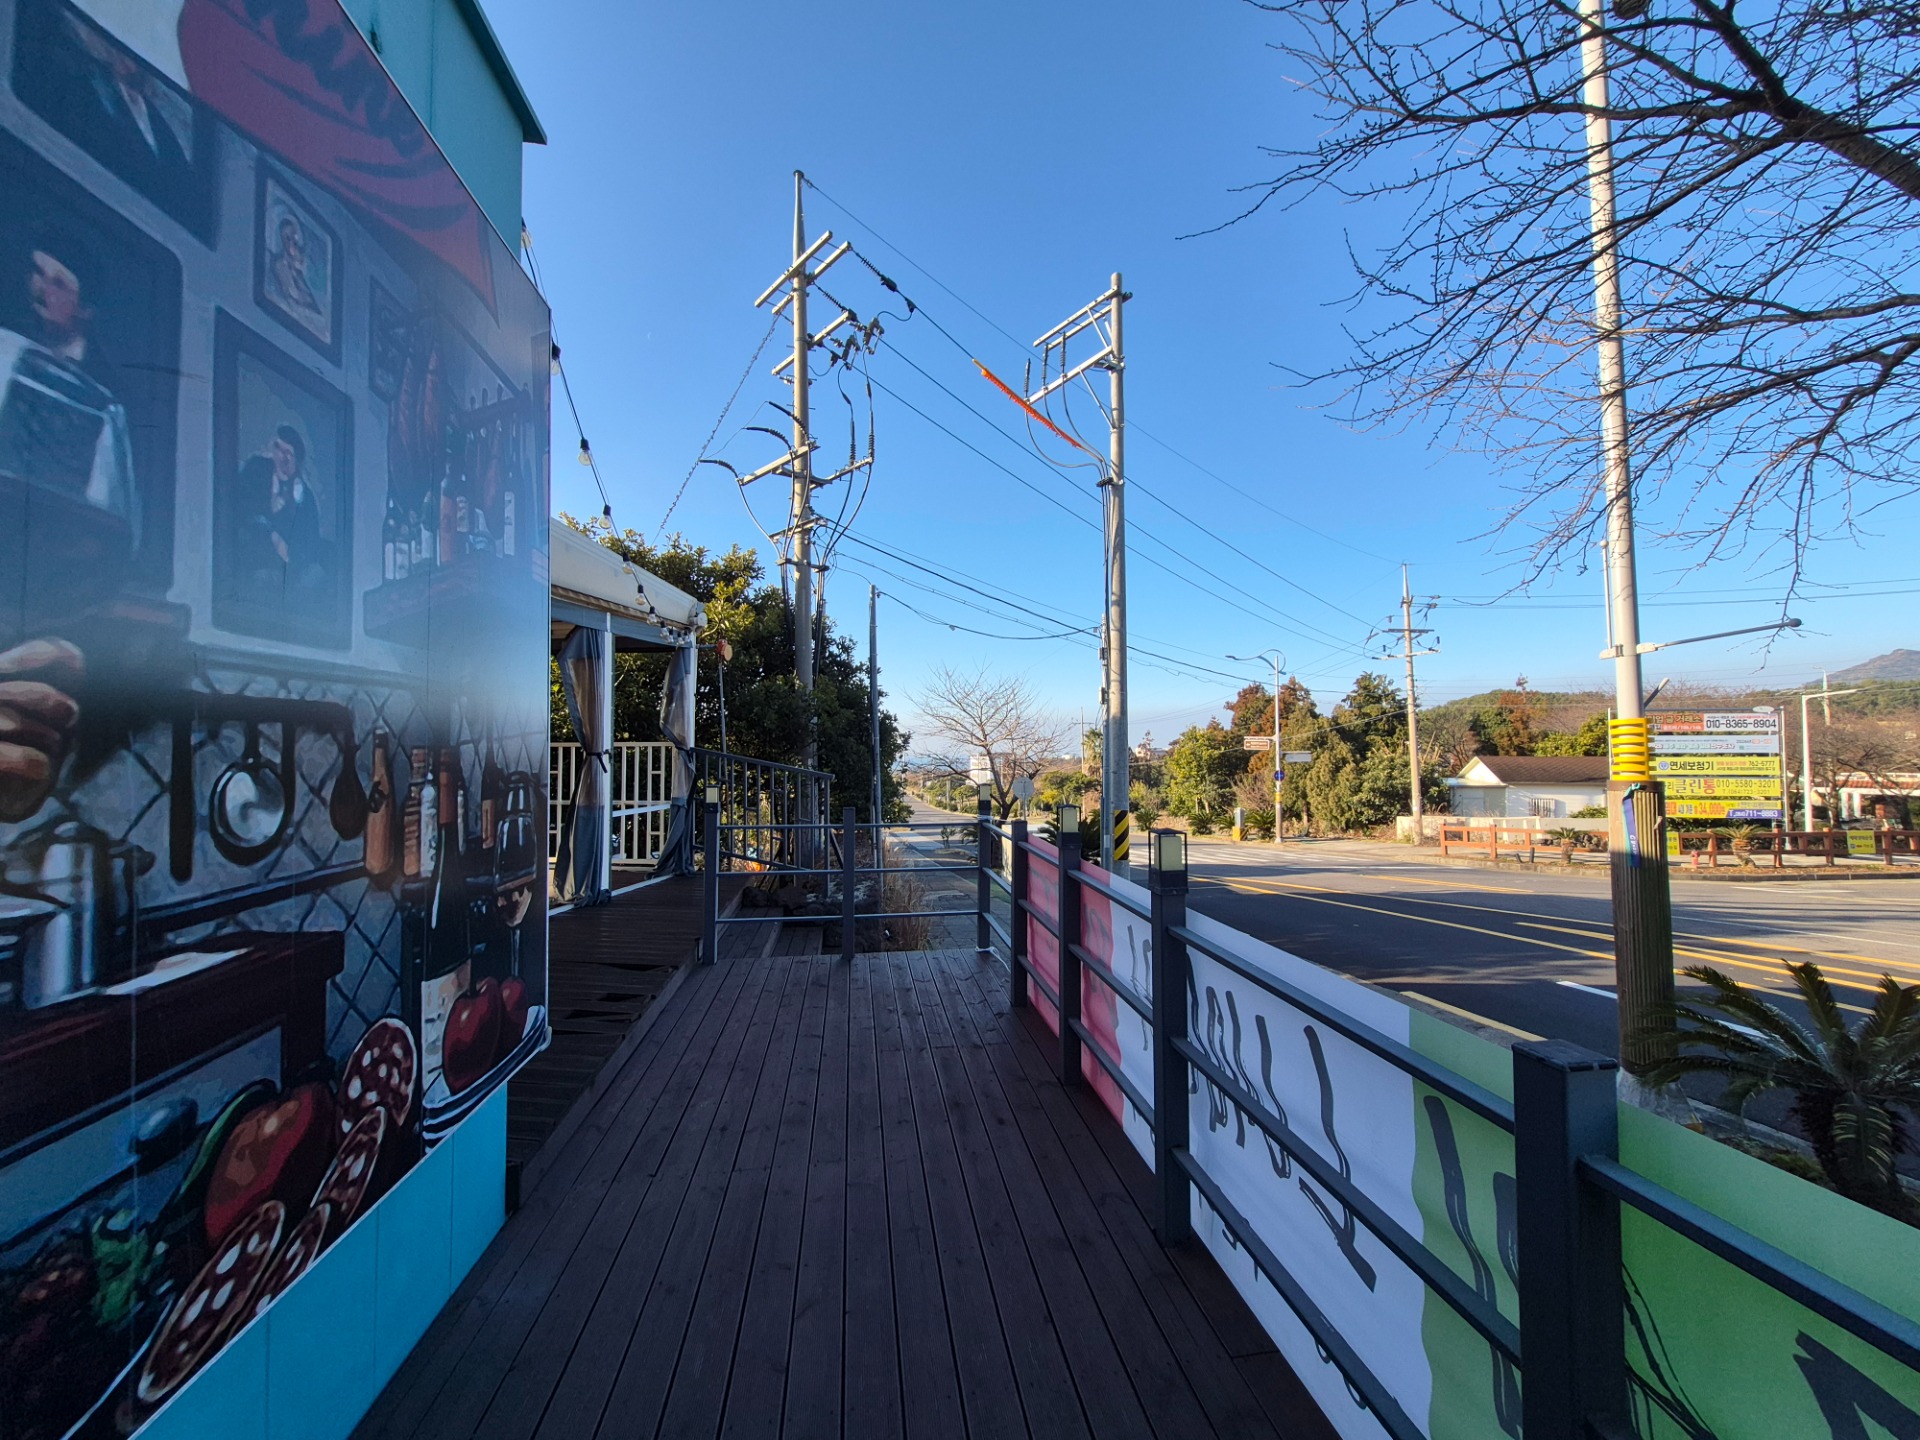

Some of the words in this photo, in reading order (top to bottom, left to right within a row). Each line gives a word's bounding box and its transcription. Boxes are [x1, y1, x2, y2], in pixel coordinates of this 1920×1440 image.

[1706, 719, 1777, 729] 010-8365-8904
[1670, 761, 1714, 771] 연세보청기
[1716, 779, 1776, 788] 010-5580-3201
